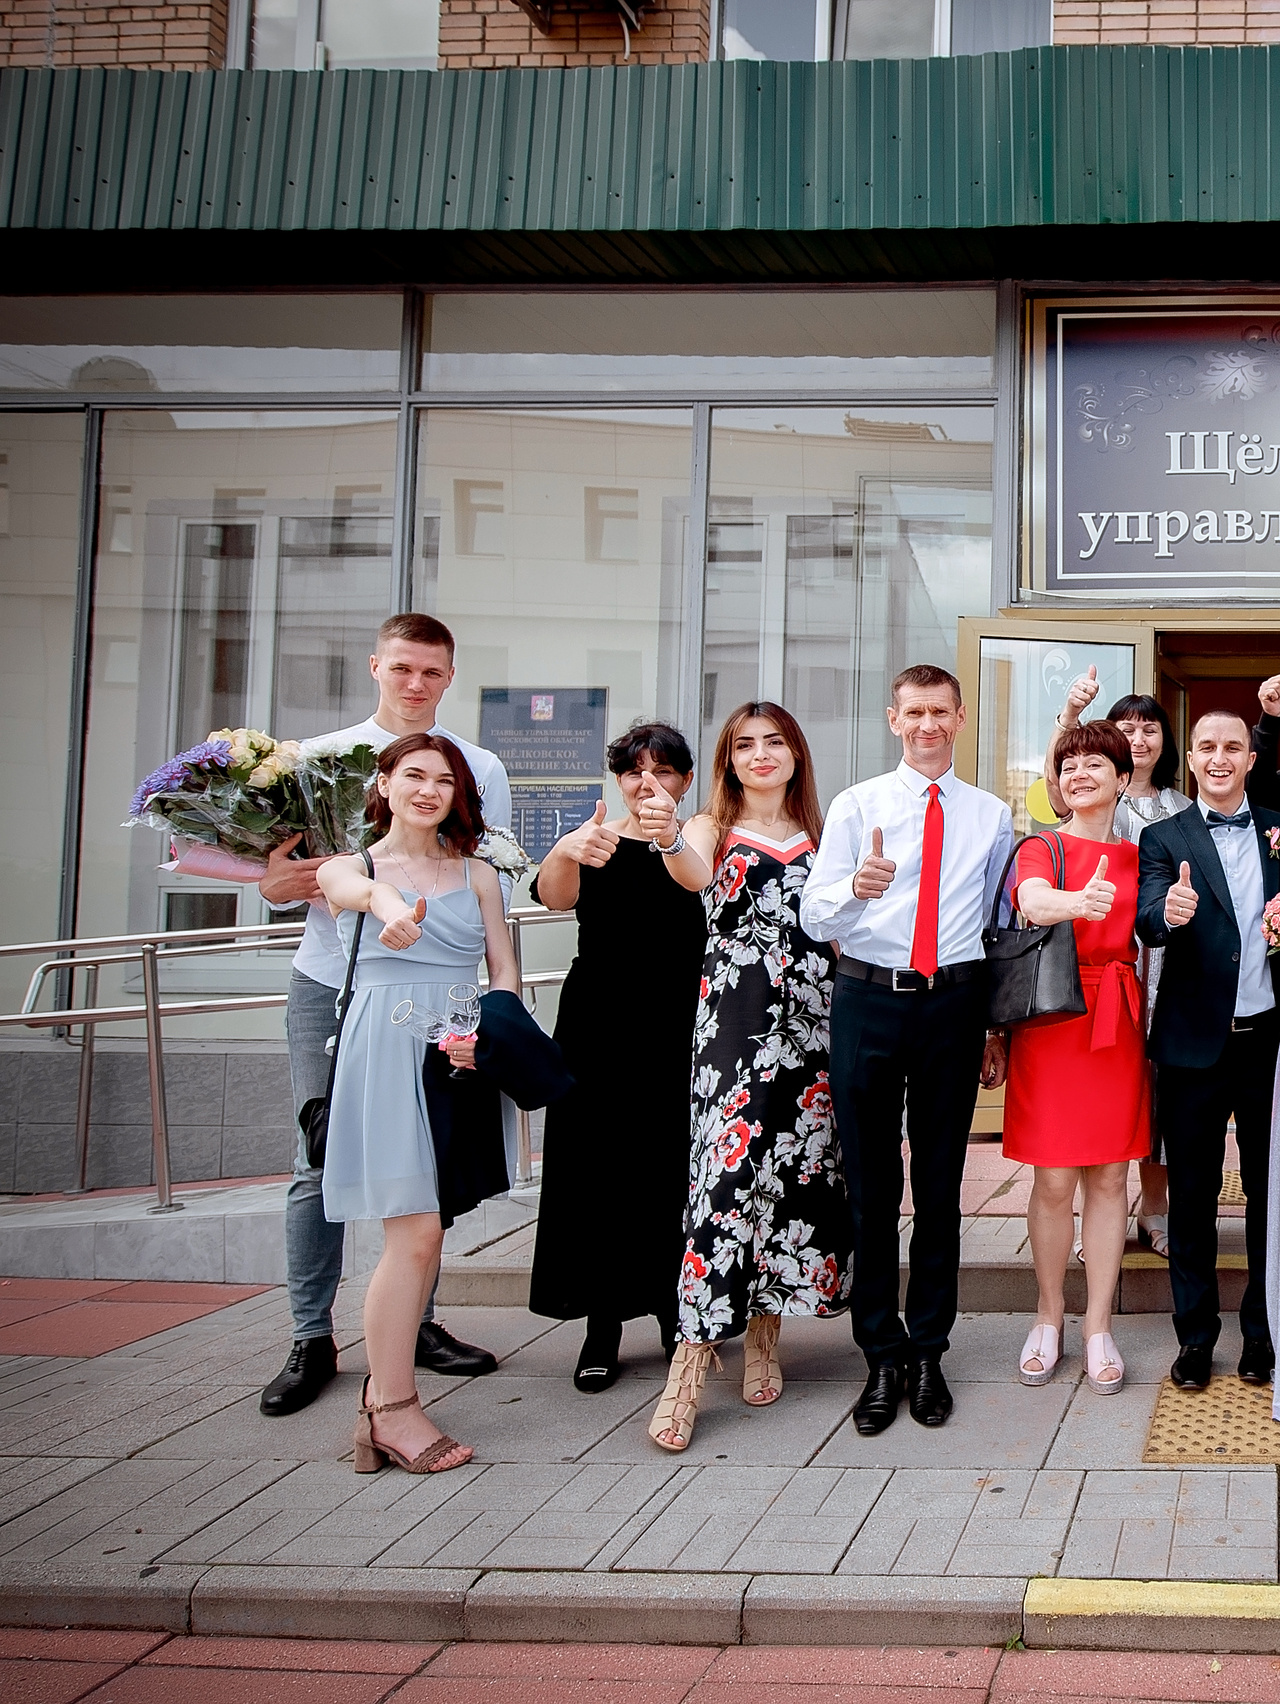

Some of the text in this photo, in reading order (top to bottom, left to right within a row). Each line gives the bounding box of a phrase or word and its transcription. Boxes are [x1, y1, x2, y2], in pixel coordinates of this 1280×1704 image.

[497, 736, 549, 744] МОСКОВСКОЙ
[499, 748, 579, 759] ЩЁЛКОВСКОЕ
[503, 761, 591, 770] РАВЛЕНИЕ ЗАГС
